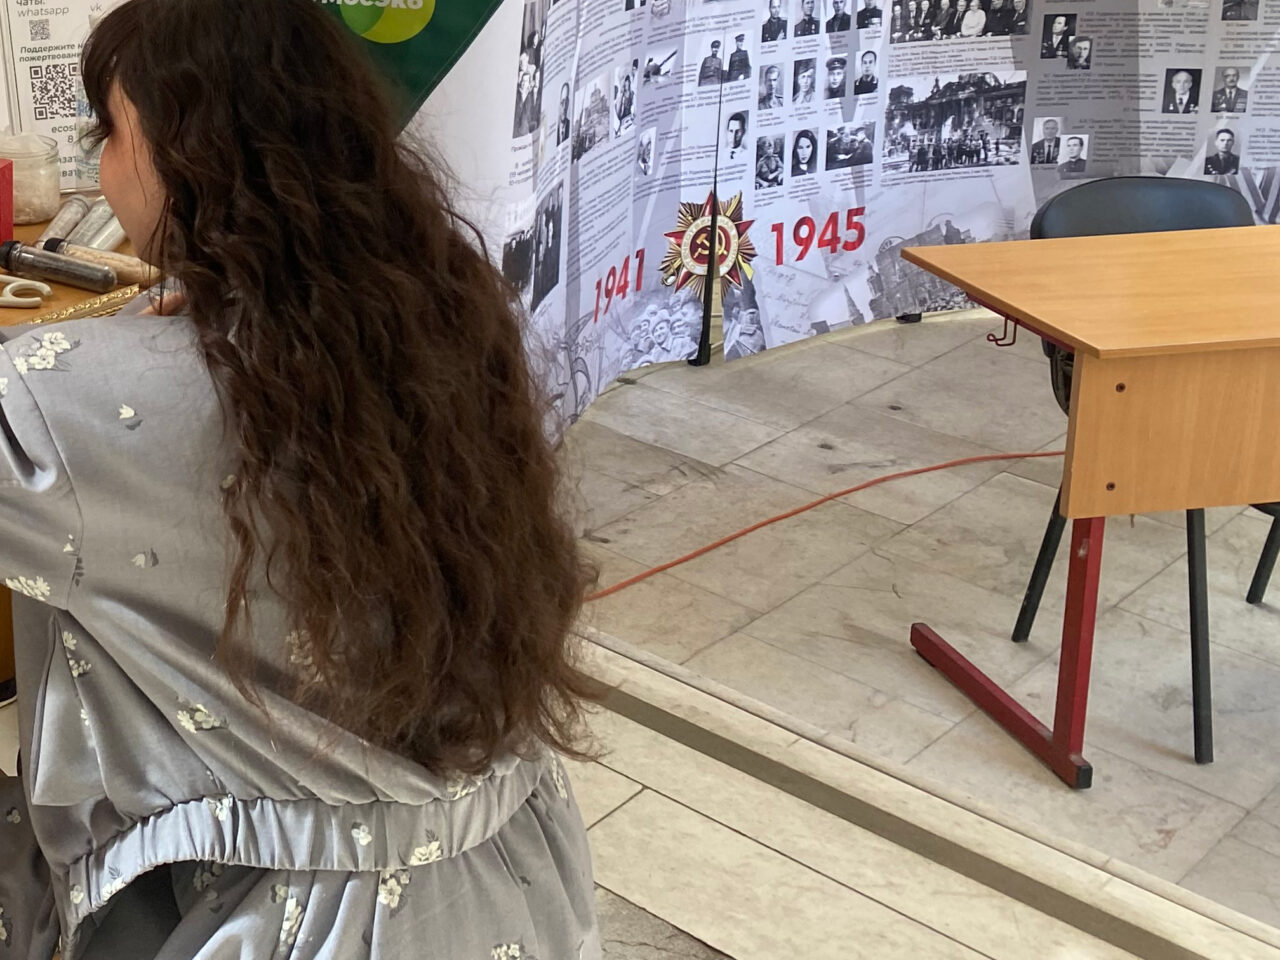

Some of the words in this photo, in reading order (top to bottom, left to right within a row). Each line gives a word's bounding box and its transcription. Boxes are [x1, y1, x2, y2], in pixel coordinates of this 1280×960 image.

[17, 6, 70, 18] whatsapp
[90, 3, 102, 12] vk
[20, 43, 75, 54] Поддержите
[771, 207, 866, 266] 1945
[594, 248, 645, 324] 1941
